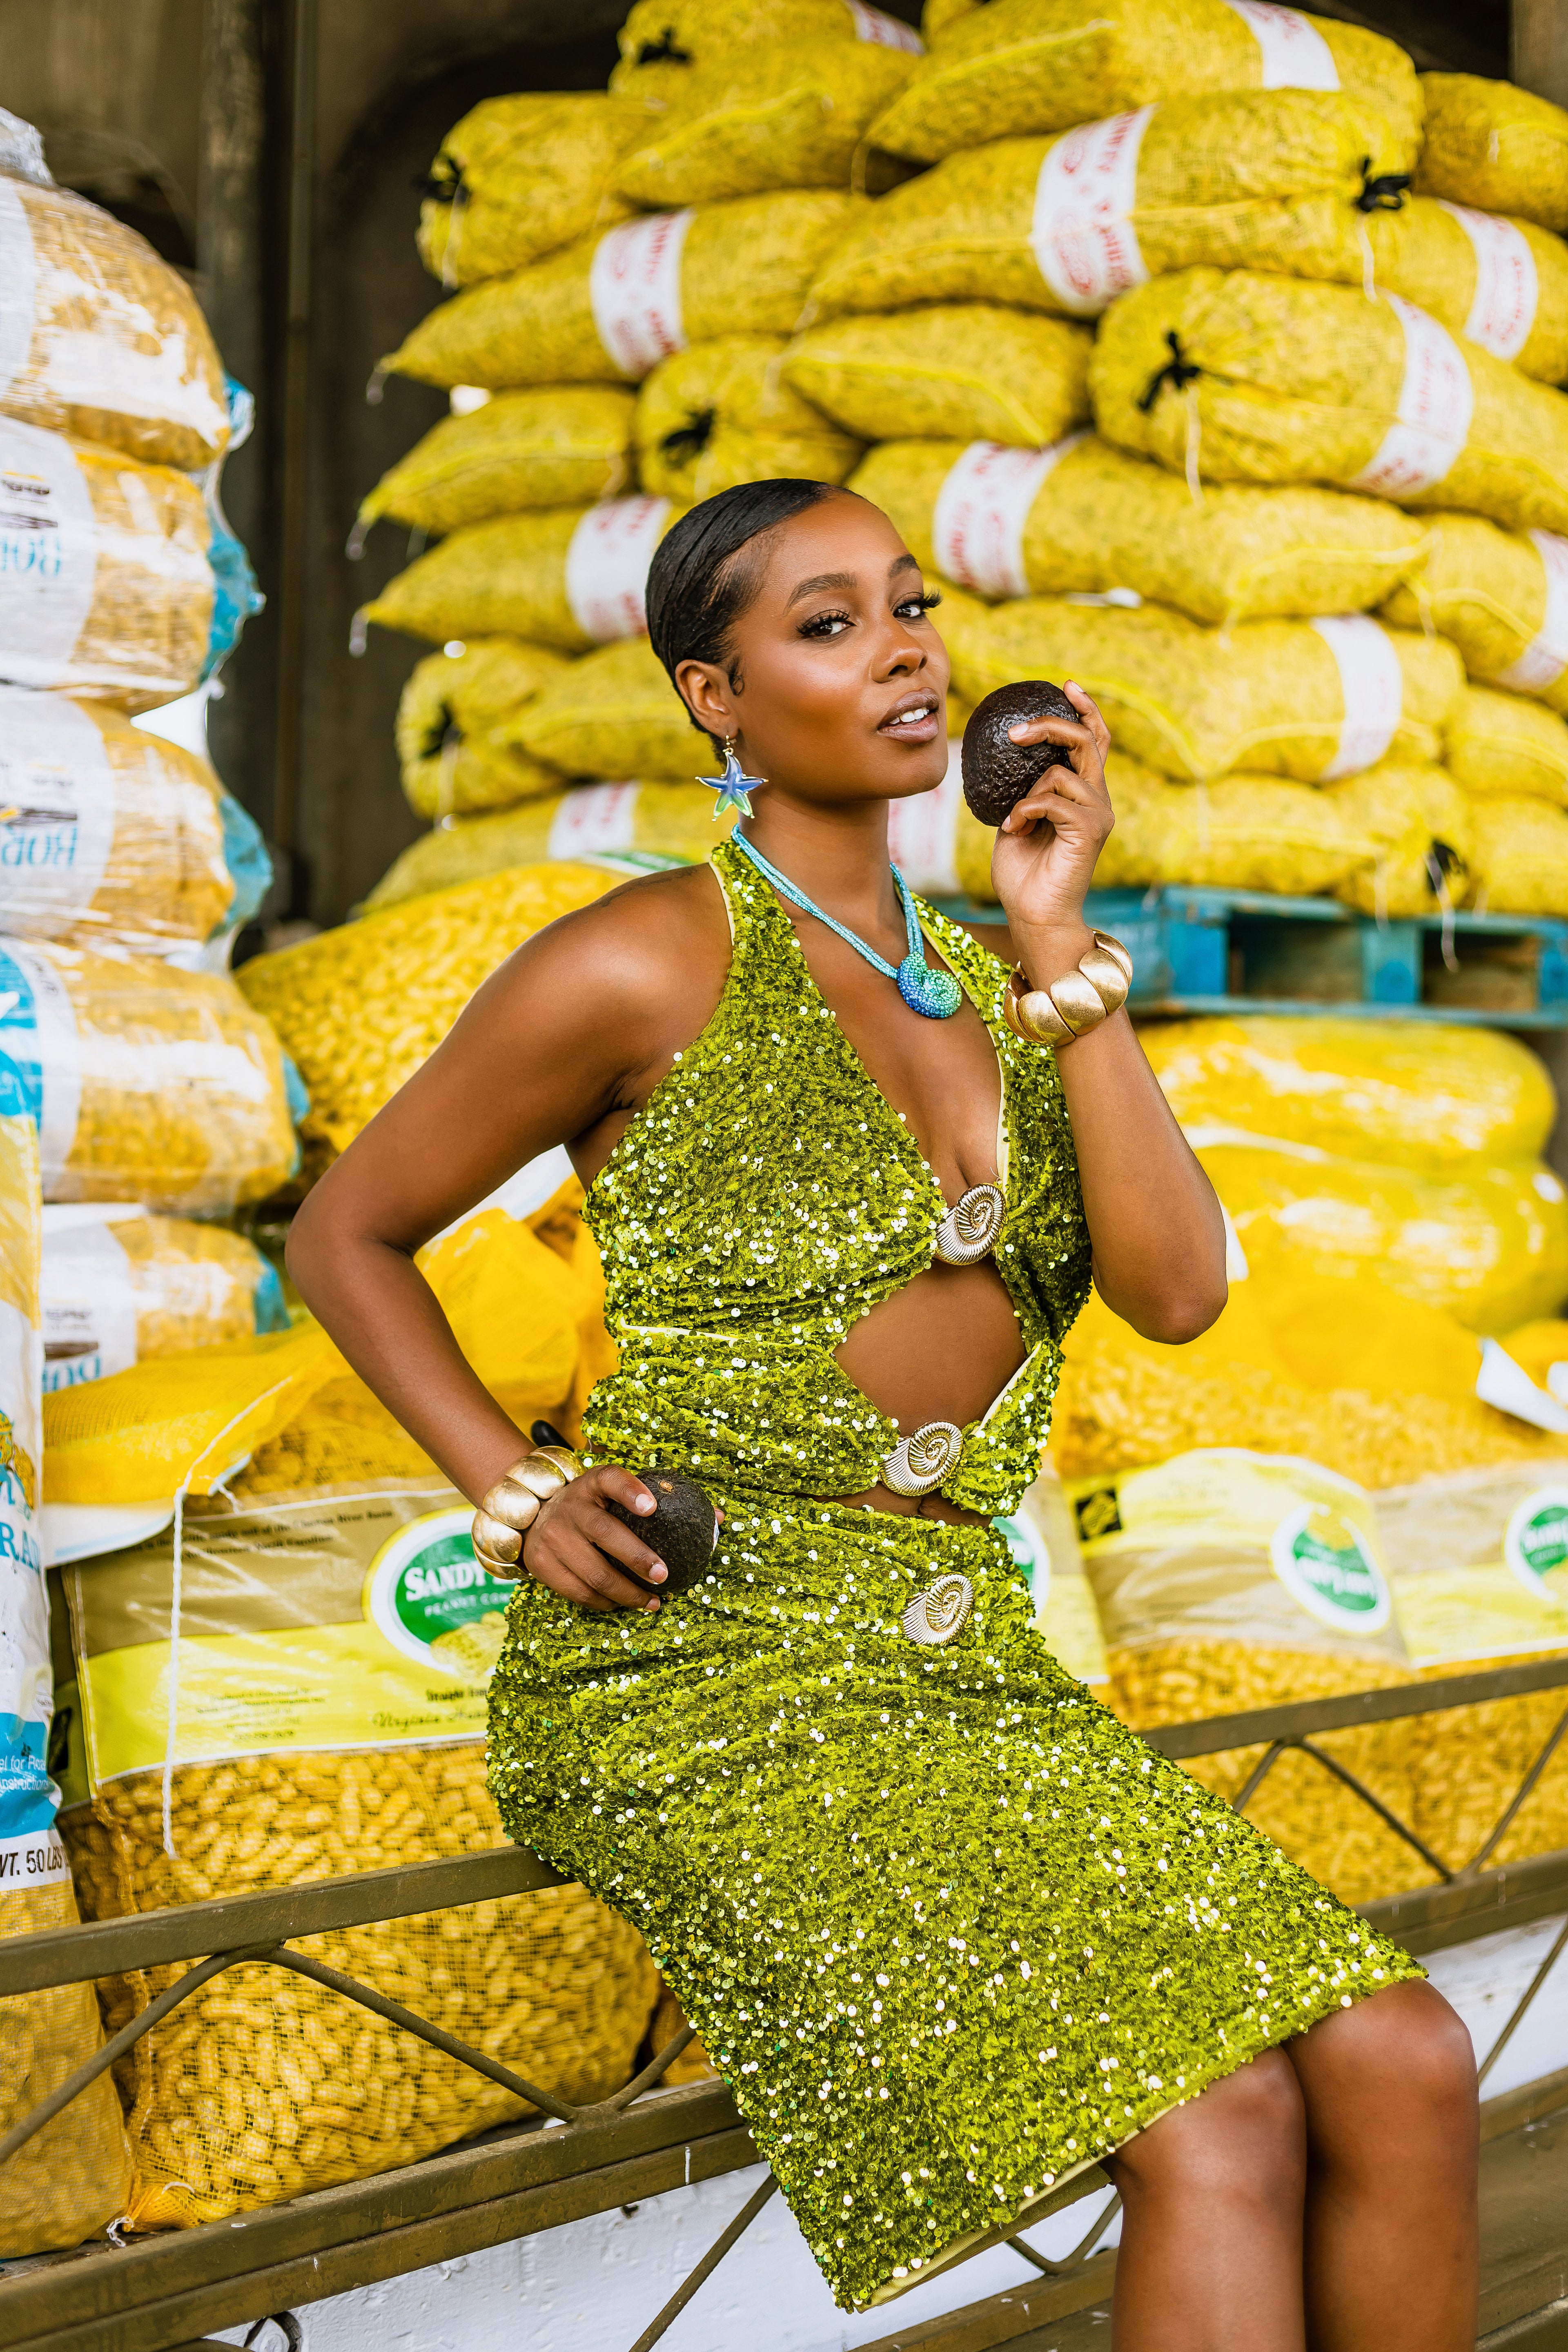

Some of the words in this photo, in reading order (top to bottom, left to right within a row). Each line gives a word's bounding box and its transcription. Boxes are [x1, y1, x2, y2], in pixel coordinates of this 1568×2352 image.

[404, 1560, 487, 1602] SANDY
[424, 1595, 477, 1617] PEANUT
[11, 1755, 24, 1771] for
[27, 1849, 44, 1874] 50
